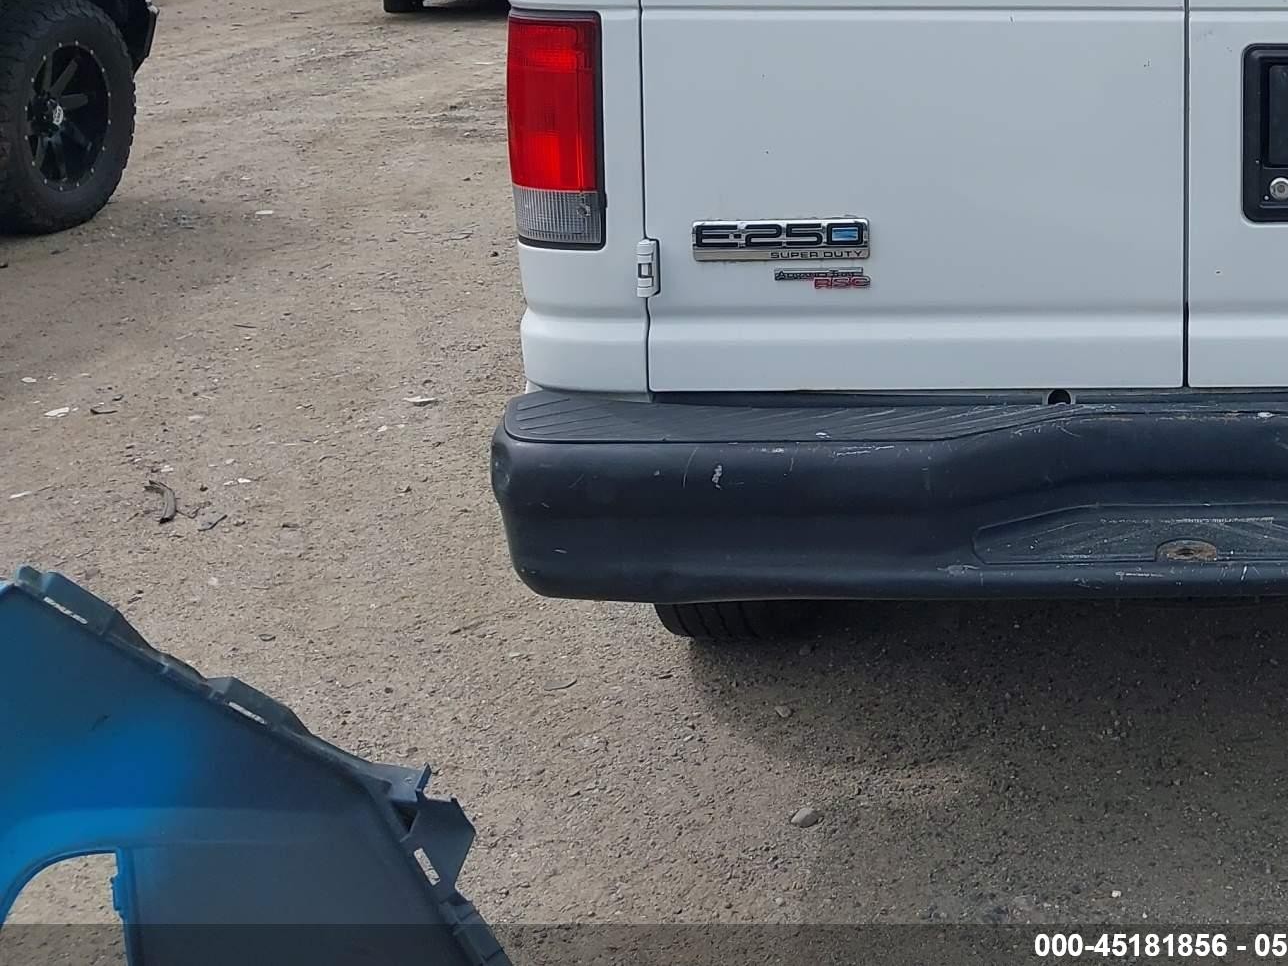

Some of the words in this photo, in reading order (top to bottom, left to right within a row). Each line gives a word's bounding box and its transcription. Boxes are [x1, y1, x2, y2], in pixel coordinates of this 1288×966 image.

[695, 223, 864, 248] E-250
[770, 250, 819, 260] SUPER
[823, 250, 863, 259] DUTY
